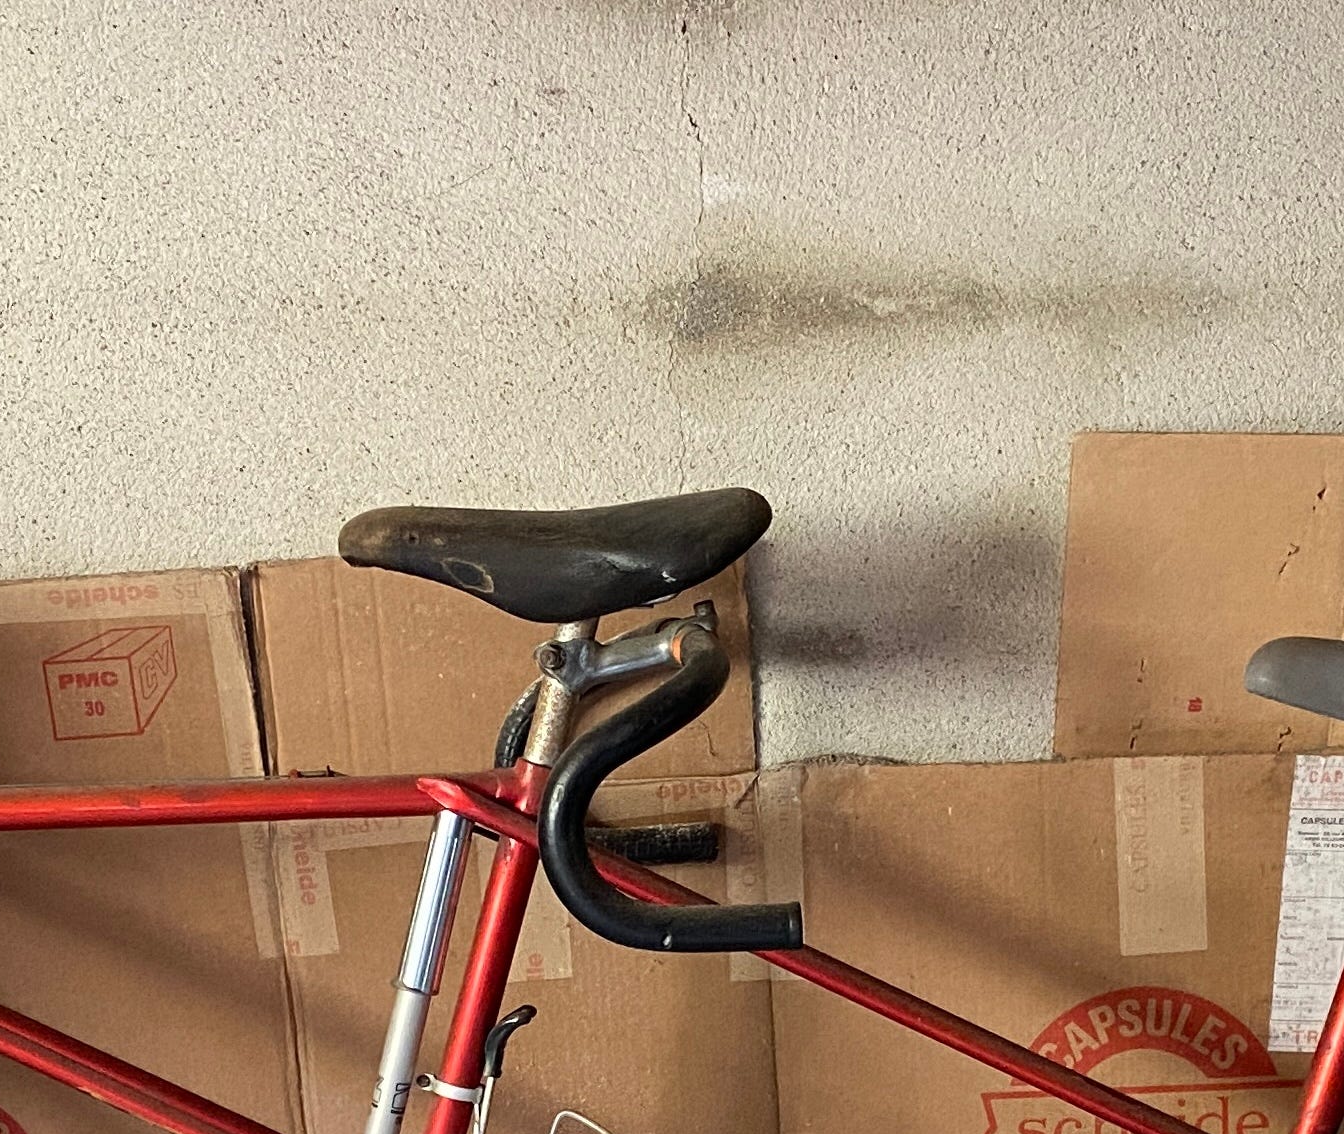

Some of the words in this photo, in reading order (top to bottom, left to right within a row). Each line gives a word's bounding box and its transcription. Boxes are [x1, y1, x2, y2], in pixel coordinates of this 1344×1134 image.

[139, 640, 170, 700] CV
[58, 671, 119, 690] PMC
[84, 700, 105, 717] 30
